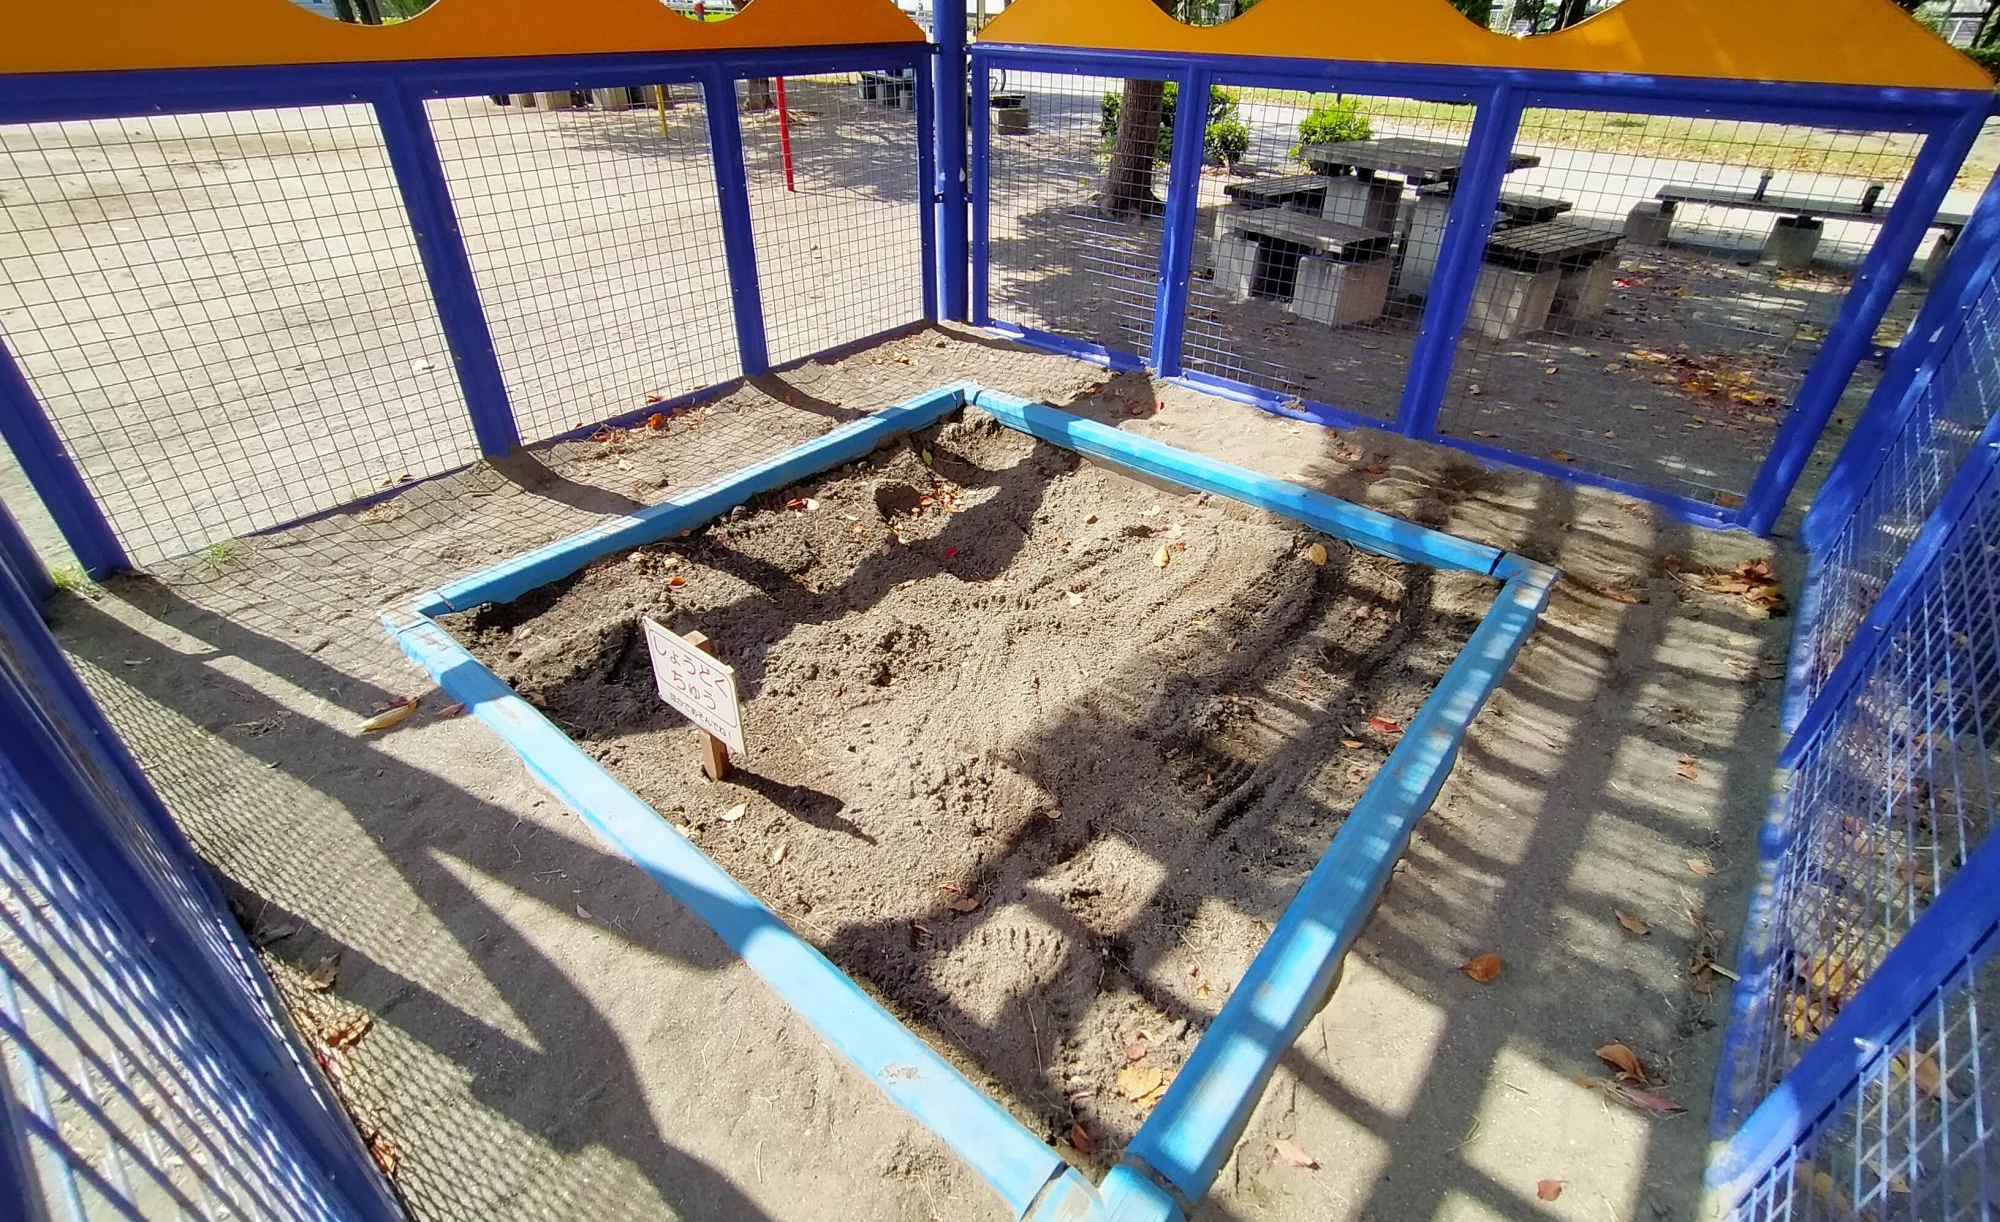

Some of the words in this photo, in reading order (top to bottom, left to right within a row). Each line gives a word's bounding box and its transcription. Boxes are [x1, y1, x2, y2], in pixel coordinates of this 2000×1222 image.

[653, 635, 728, 698] しょうどく
[672, 669, 717, 710] ちゅう
